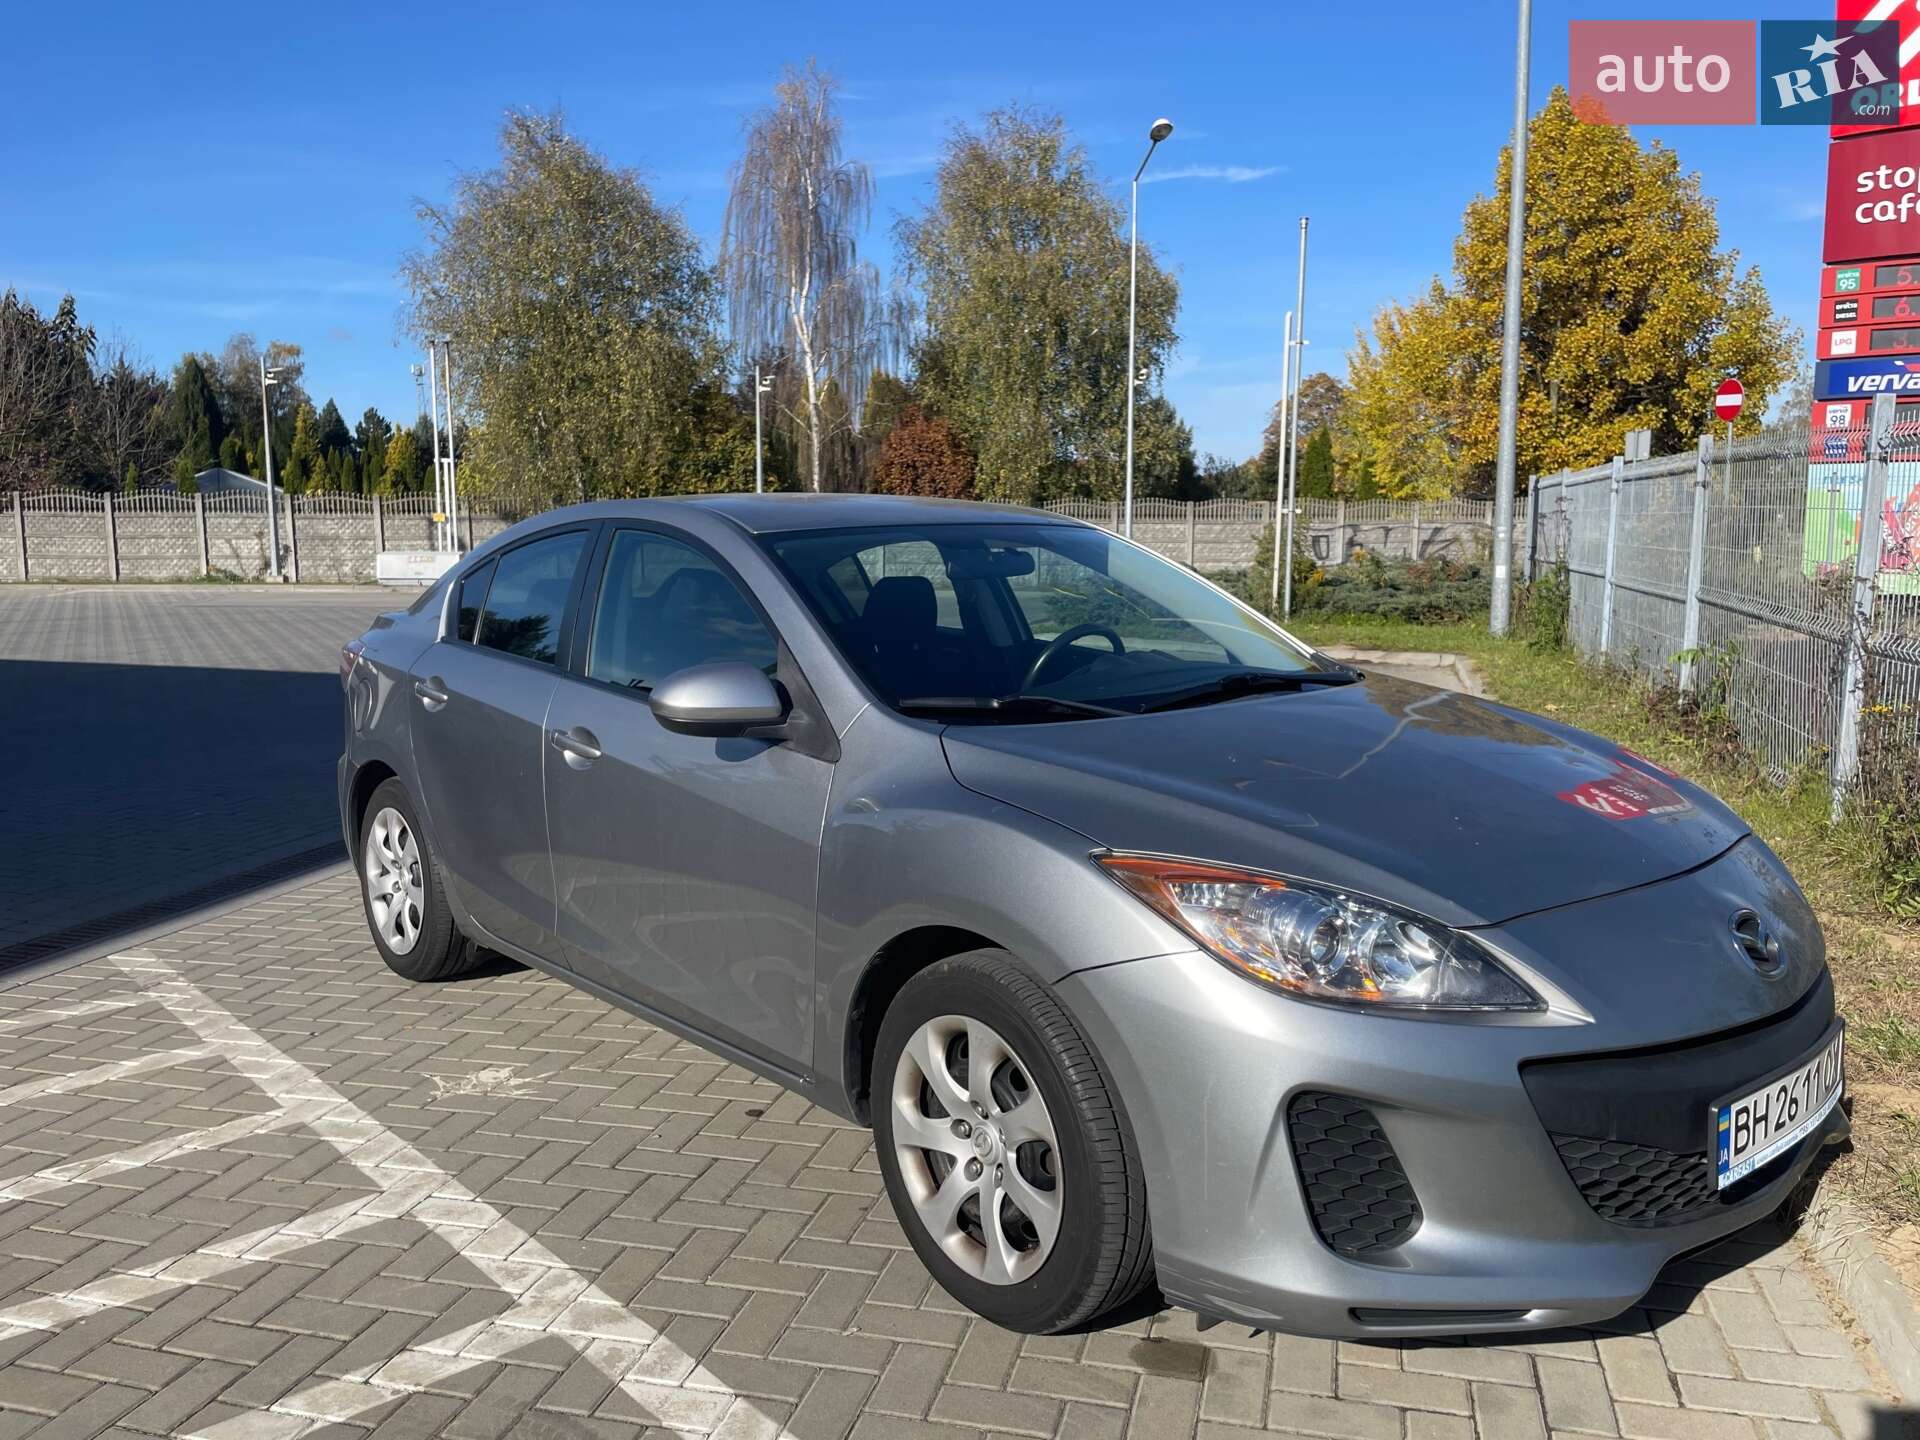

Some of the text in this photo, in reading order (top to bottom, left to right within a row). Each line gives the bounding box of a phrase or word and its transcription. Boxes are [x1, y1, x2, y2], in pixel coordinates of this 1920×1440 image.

[1857, 164, 1920, 194] sto
[1855, 192, 1920, 224] caf
[1840, 278, 1857, 290] 95
[1835, 337, 1852, 346] LPG
[1848, 373, 1920, 392] verva
[1831, 415, 1846, 425] 98
